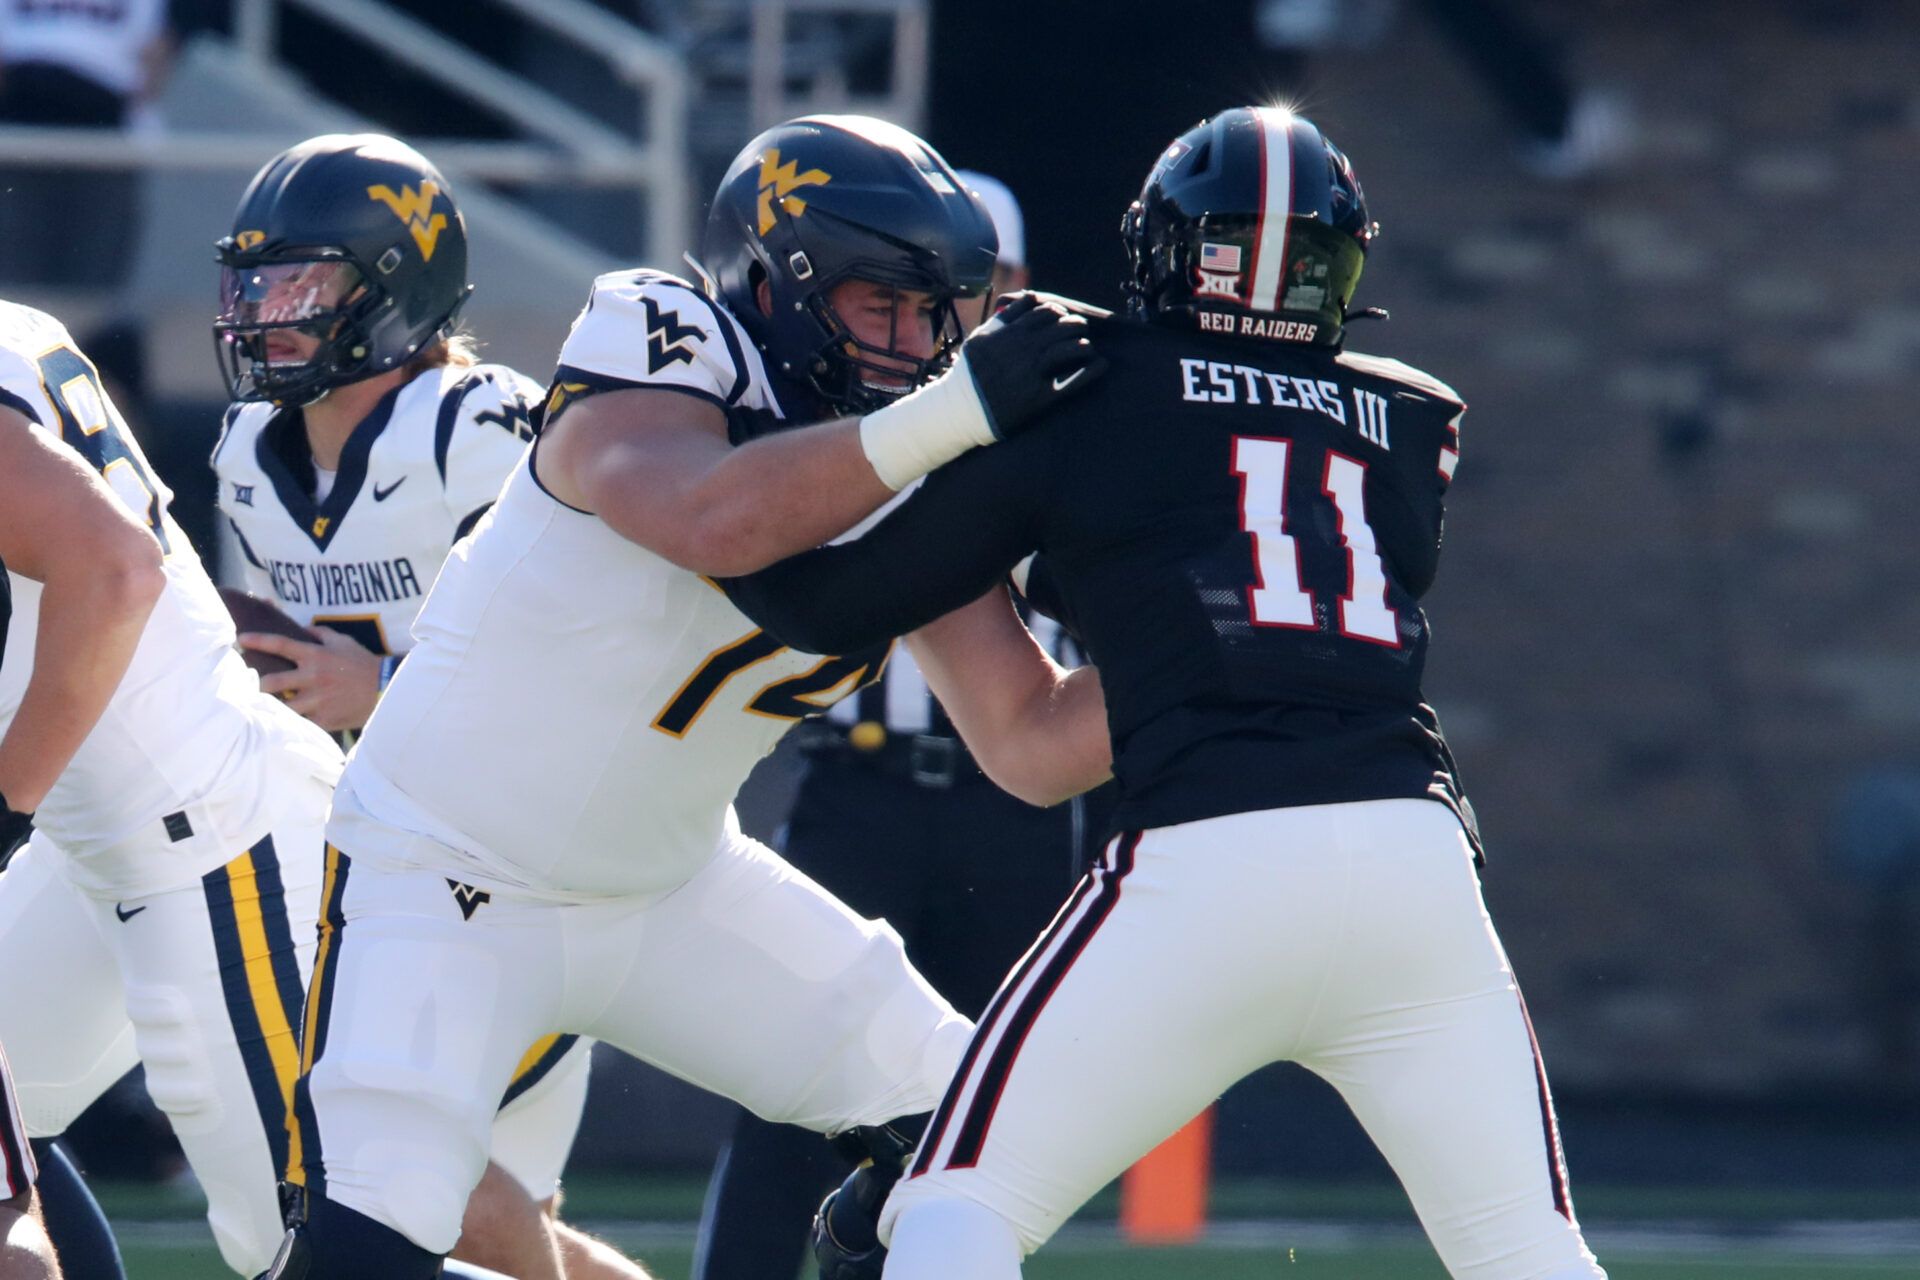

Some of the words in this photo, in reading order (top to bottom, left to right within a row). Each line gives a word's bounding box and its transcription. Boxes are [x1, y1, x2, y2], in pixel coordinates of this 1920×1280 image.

[1199, 311, 1235, 333] RED
[1240, 316, 1318, 342] RAIDERS
[1180, 358, 1347, 427] ESTERS
[1352, 387, 1390, 451] III
[1229, 433, 1402, 649] 11
[309, 556, 422, 606] VIRGINIA
